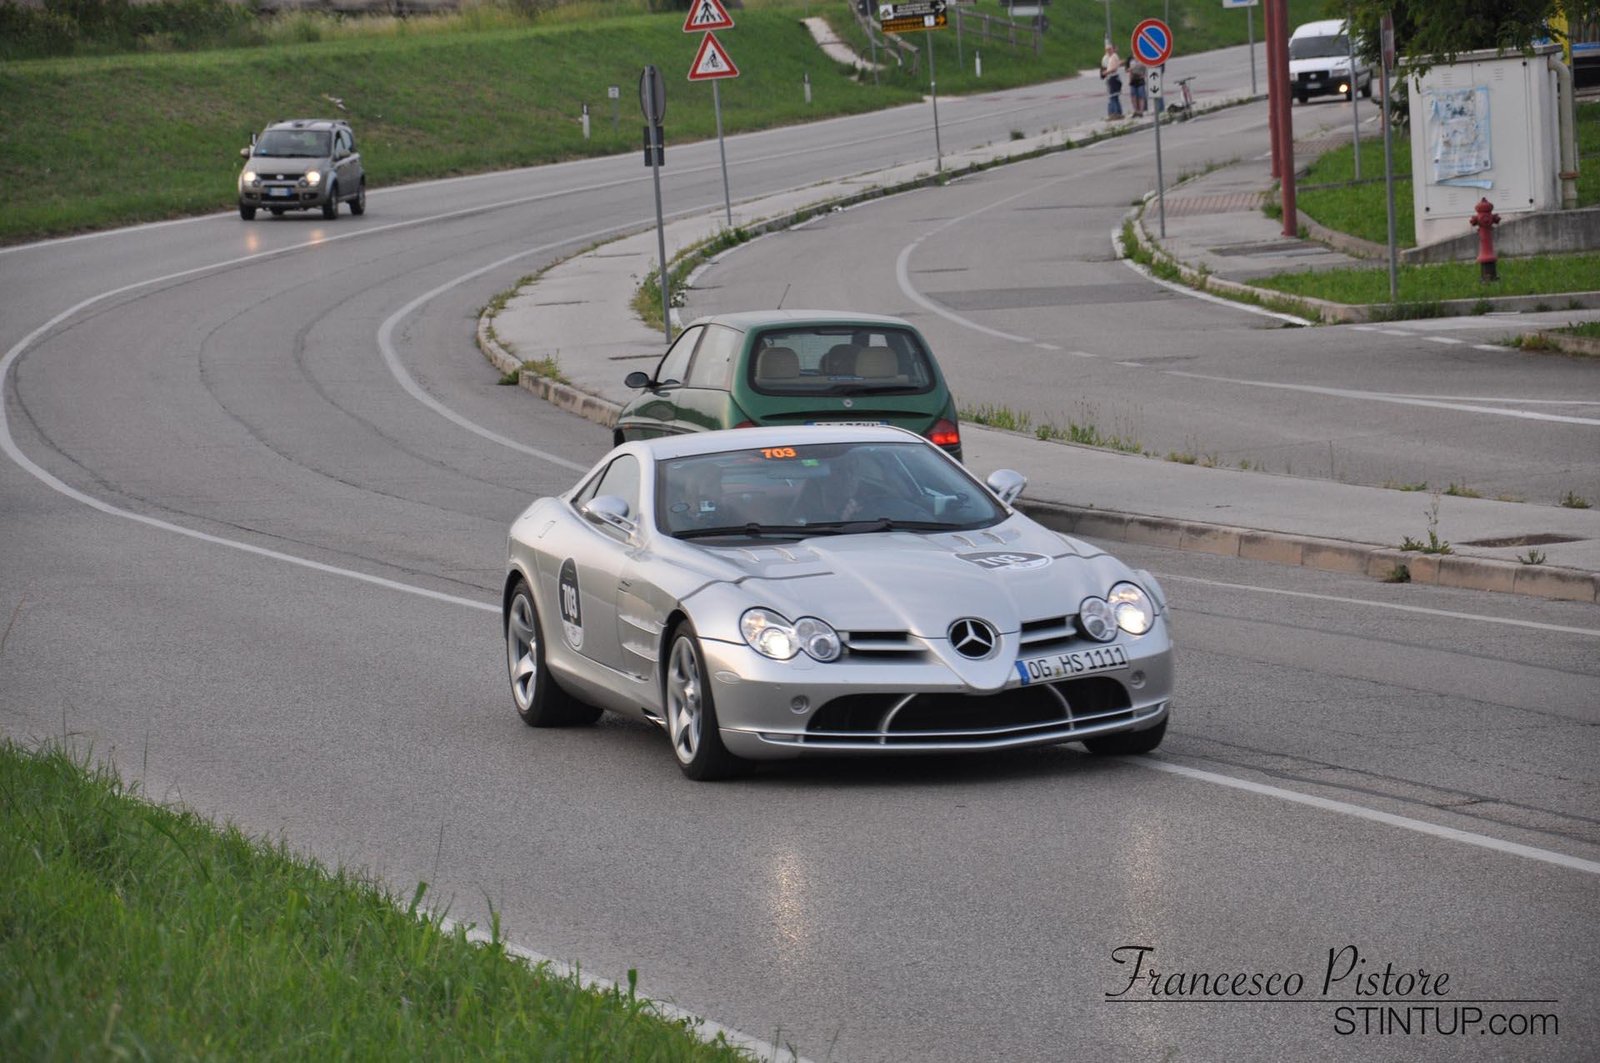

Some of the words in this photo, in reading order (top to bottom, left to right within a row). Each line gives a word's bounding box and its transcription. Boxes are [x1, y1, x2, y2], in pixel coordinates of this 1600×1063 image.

[760, 447, 796, 459] 703
[562, 584, 578, 619] 703
[1028, 660, 1052, 679] OG
[1058, 654, 1085, 674] HS
[1085, 647, 1127, 670] 1111
